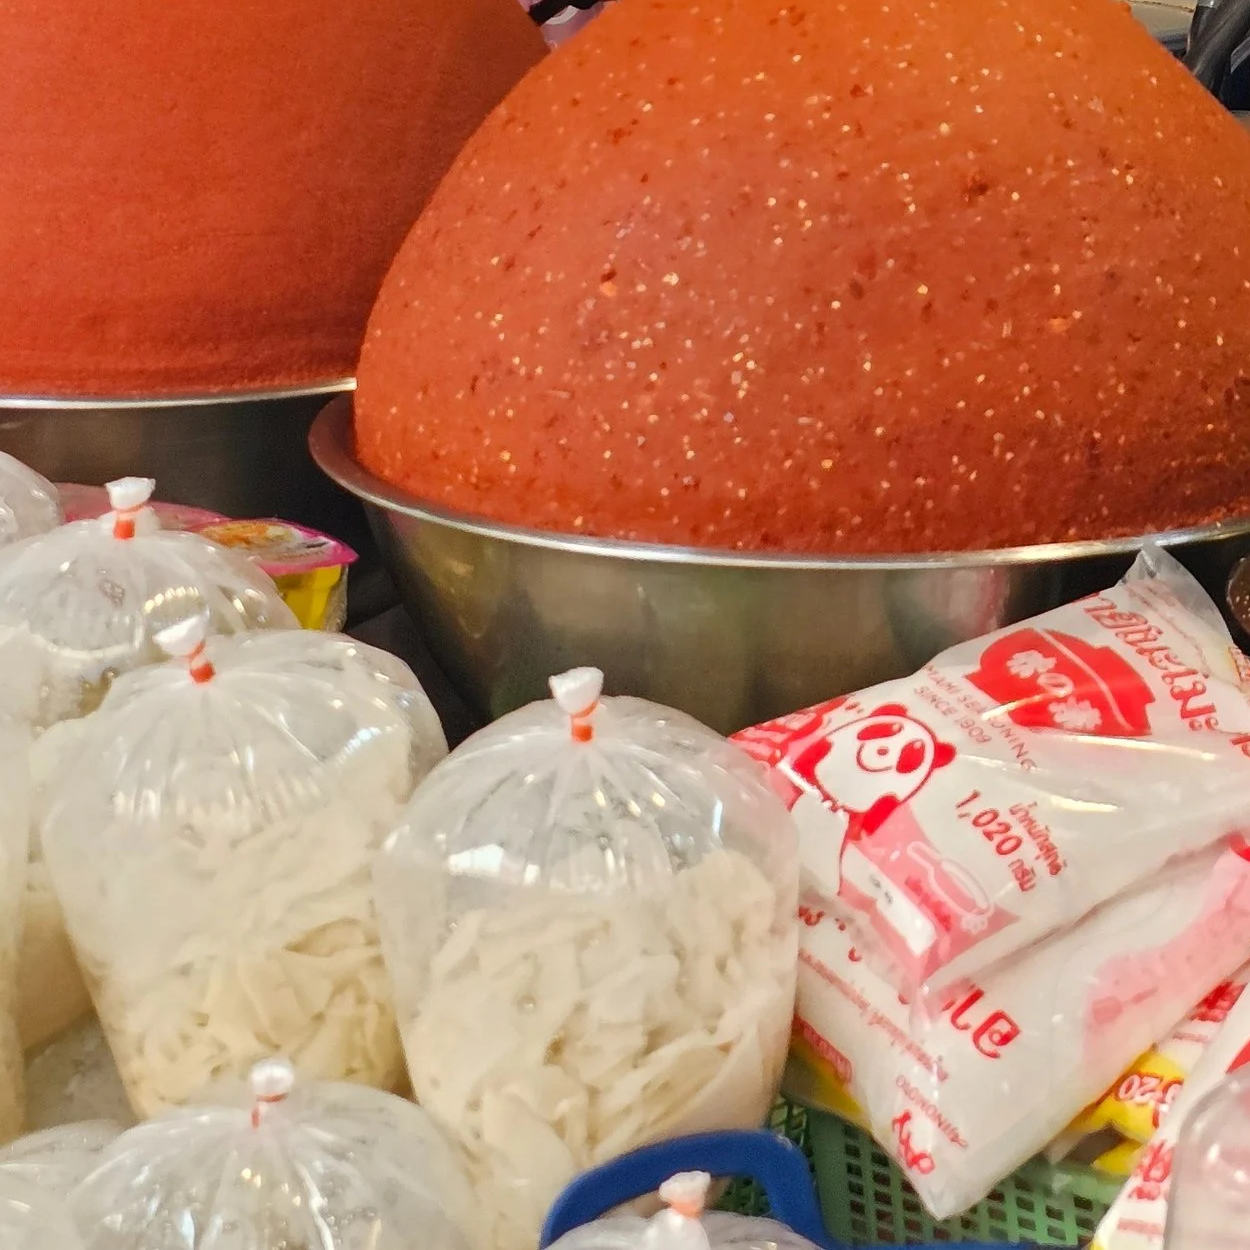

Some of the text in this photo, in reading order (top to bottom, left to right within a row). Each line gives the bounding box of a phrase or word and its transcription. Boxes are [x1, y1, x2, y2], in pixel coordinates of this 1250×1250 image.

[914, 685, 993, 744] SINCE 1909
[955, 789, 1037, 892] 1,020 กรัม
